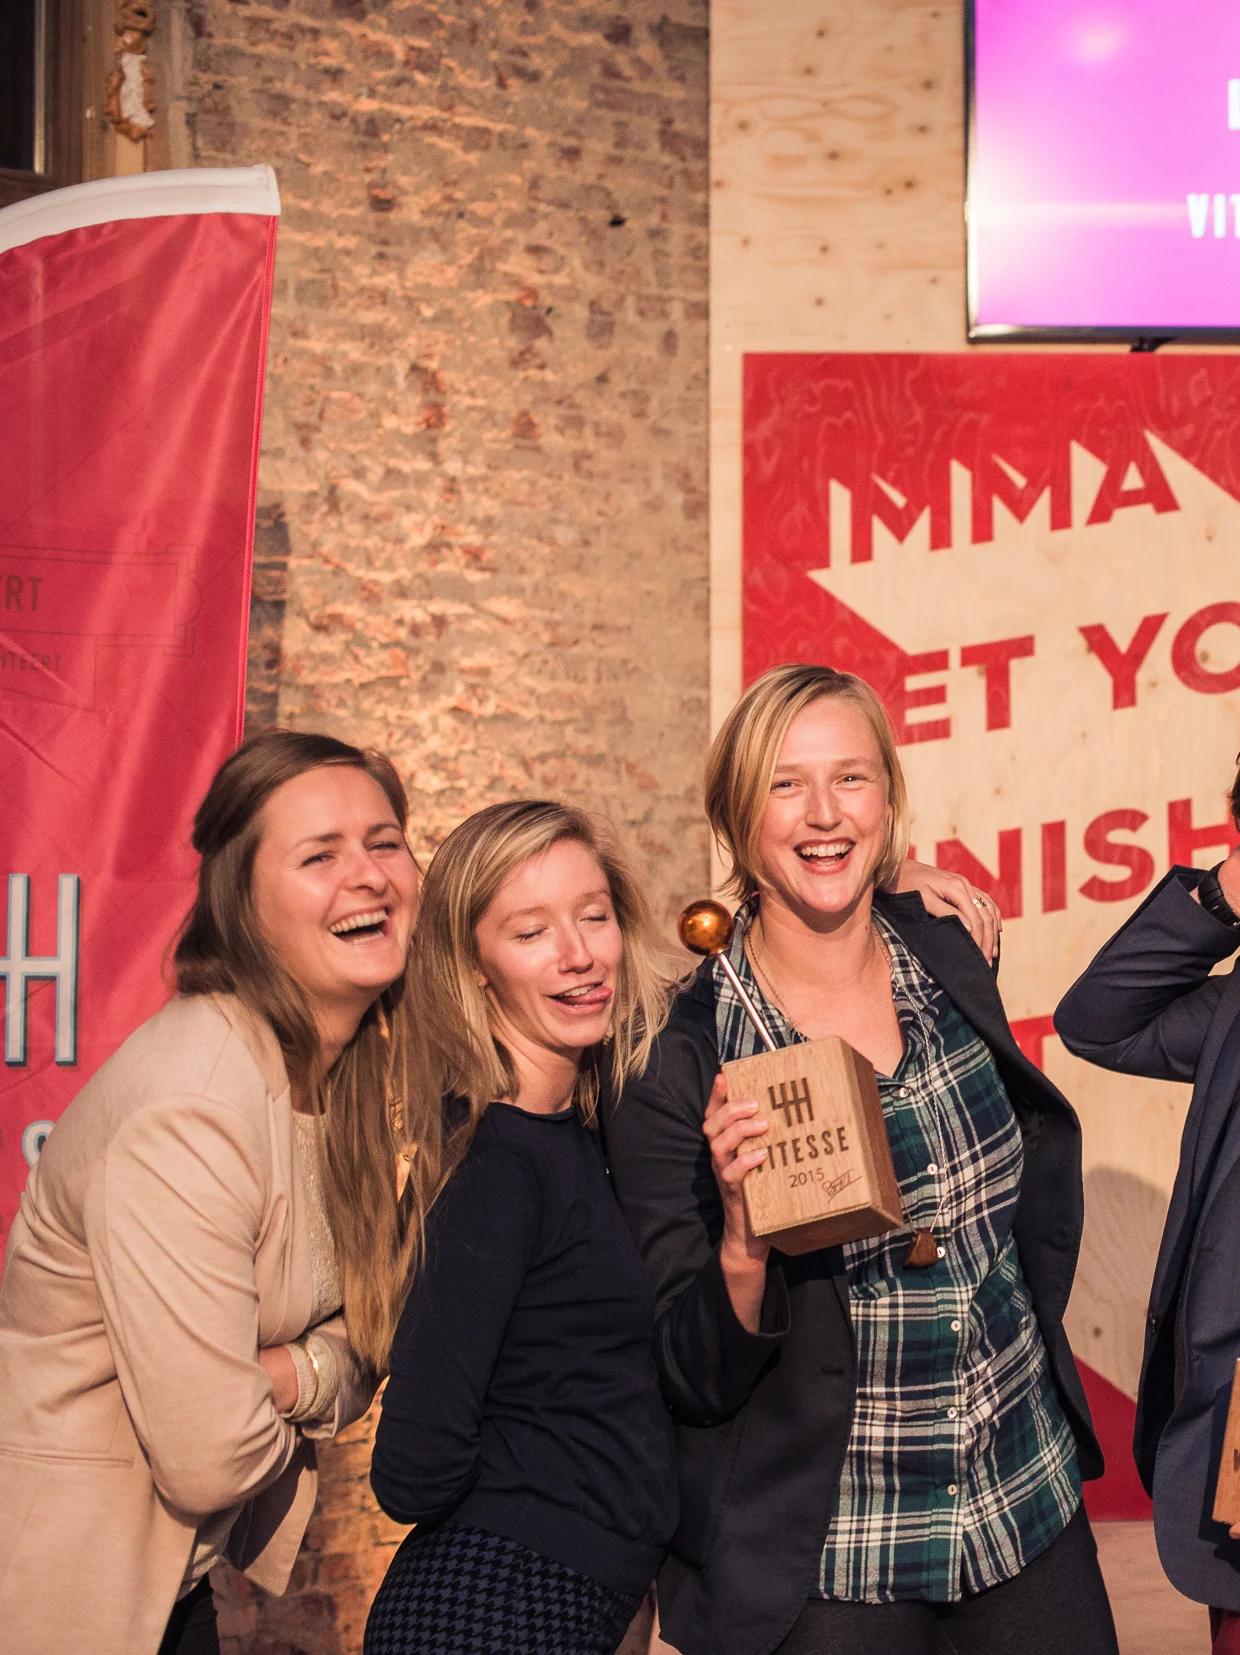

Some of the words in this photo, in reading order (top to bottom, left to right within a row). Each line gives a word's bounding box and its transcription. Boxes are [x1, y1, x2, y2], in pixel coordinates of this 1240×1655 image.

[808, 429, 1182, 572] IMMA
[0, 574, 44, 612] RT
[883, 634, 1035, 746] ET
[756, 1127, 849, 1173] ITESSE
[789, 1168, 825, 1188] 2015
